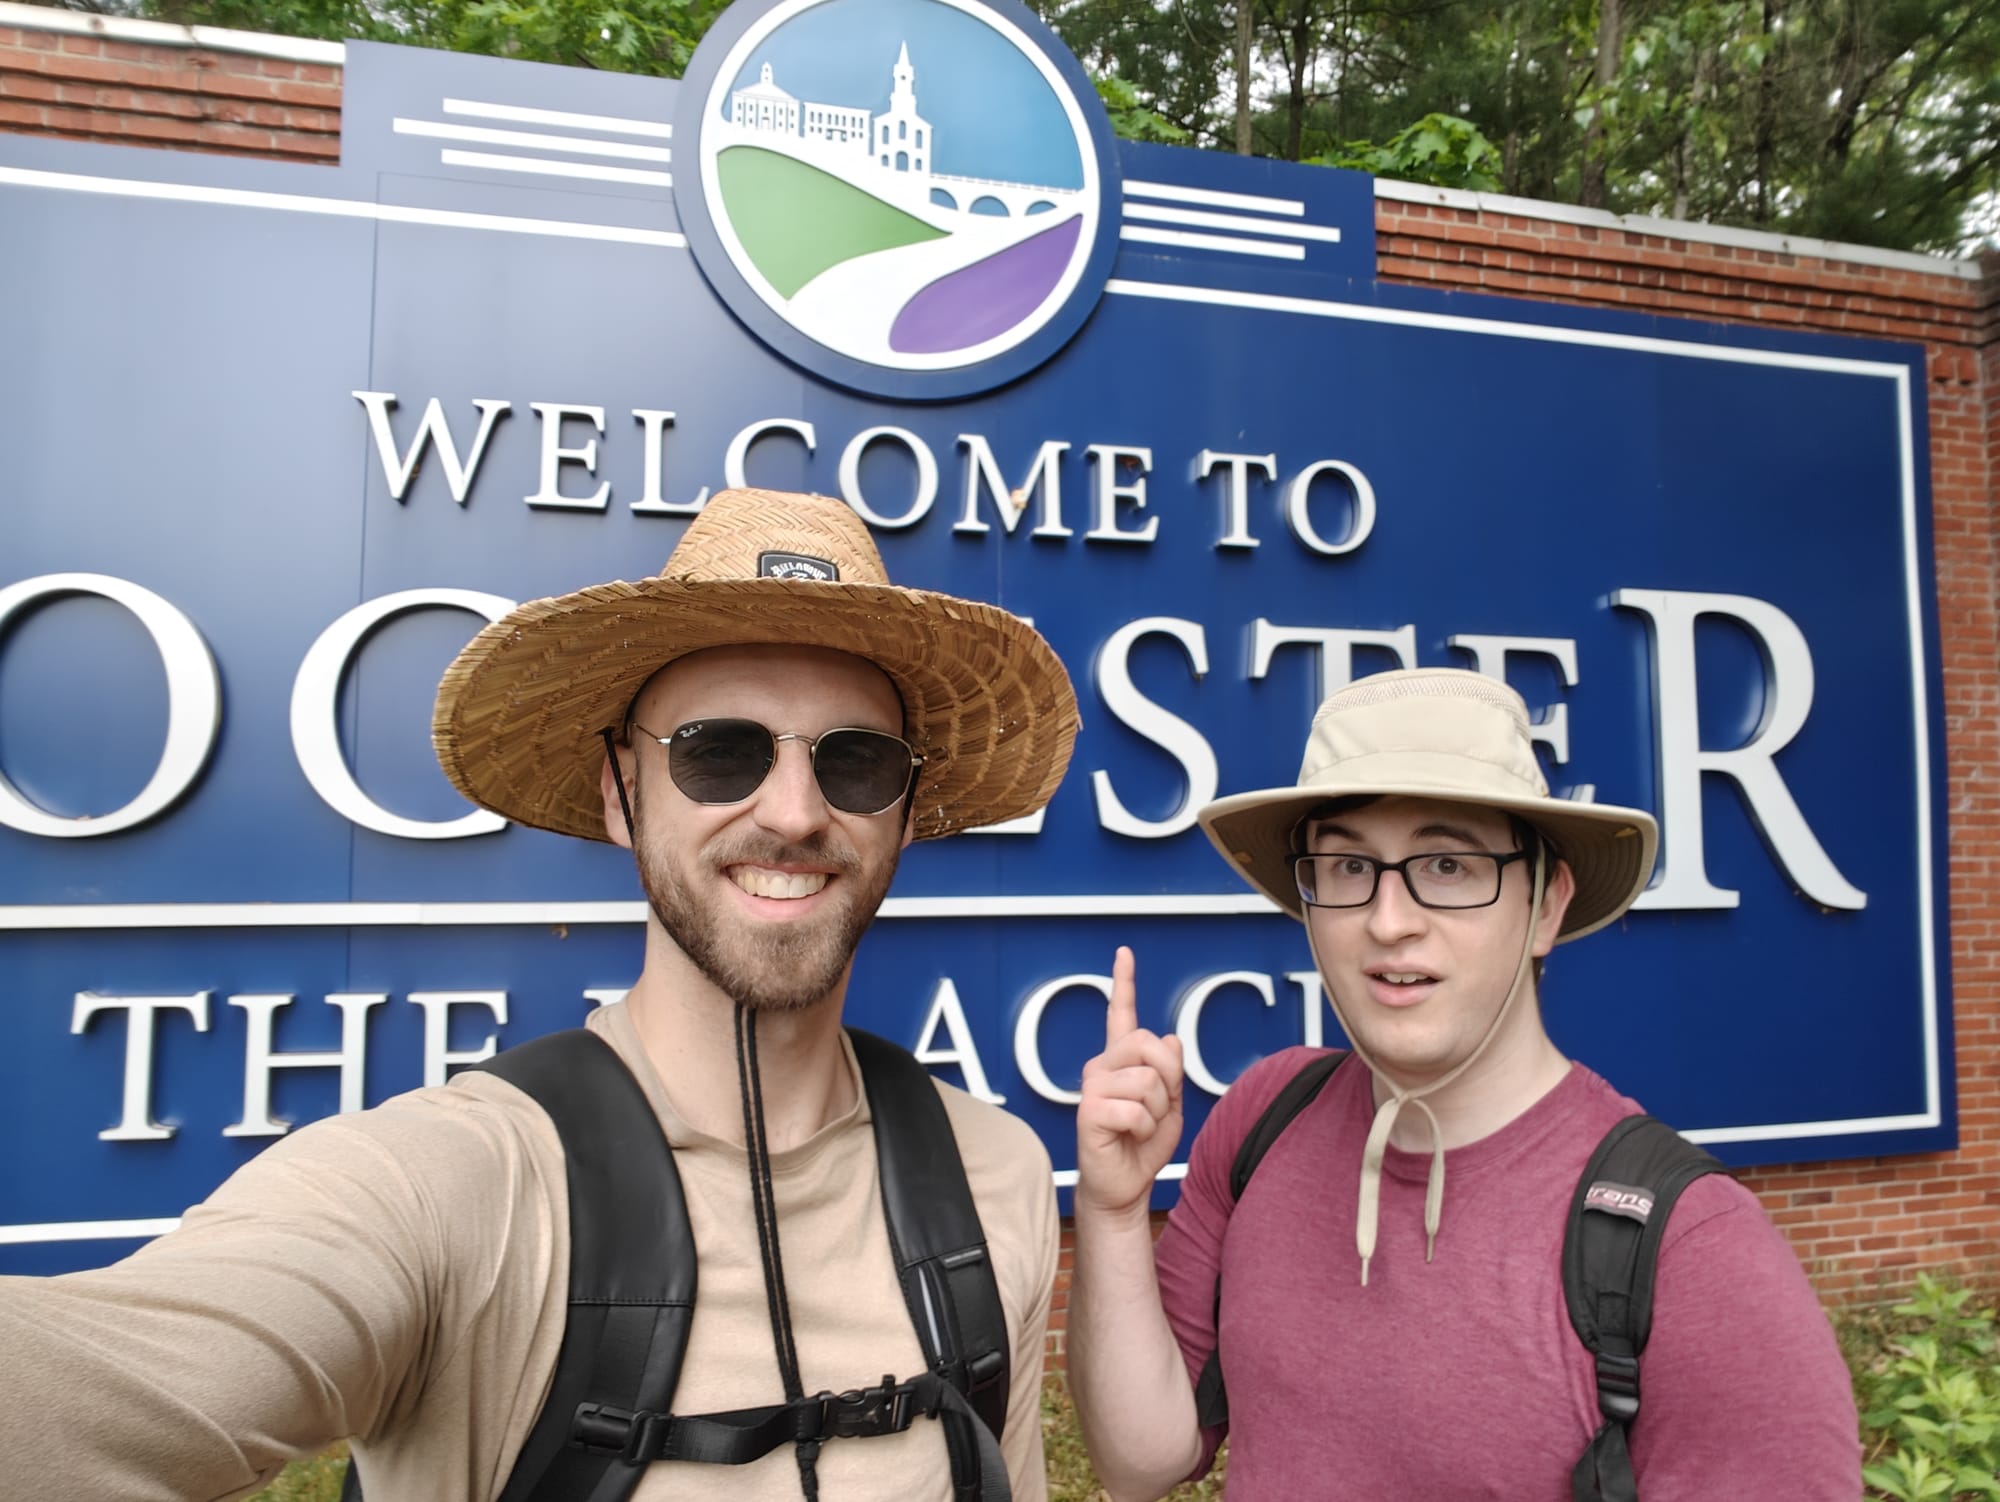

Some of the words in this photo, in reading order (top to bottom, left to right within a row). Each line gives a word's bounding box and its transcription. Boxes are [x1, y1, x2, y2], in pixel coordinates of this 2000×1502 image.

[352, 391, 1159, 543] WELCOME
[1197, 448, 1377, 555] TO
[71, 990, 508, 1140] THE
